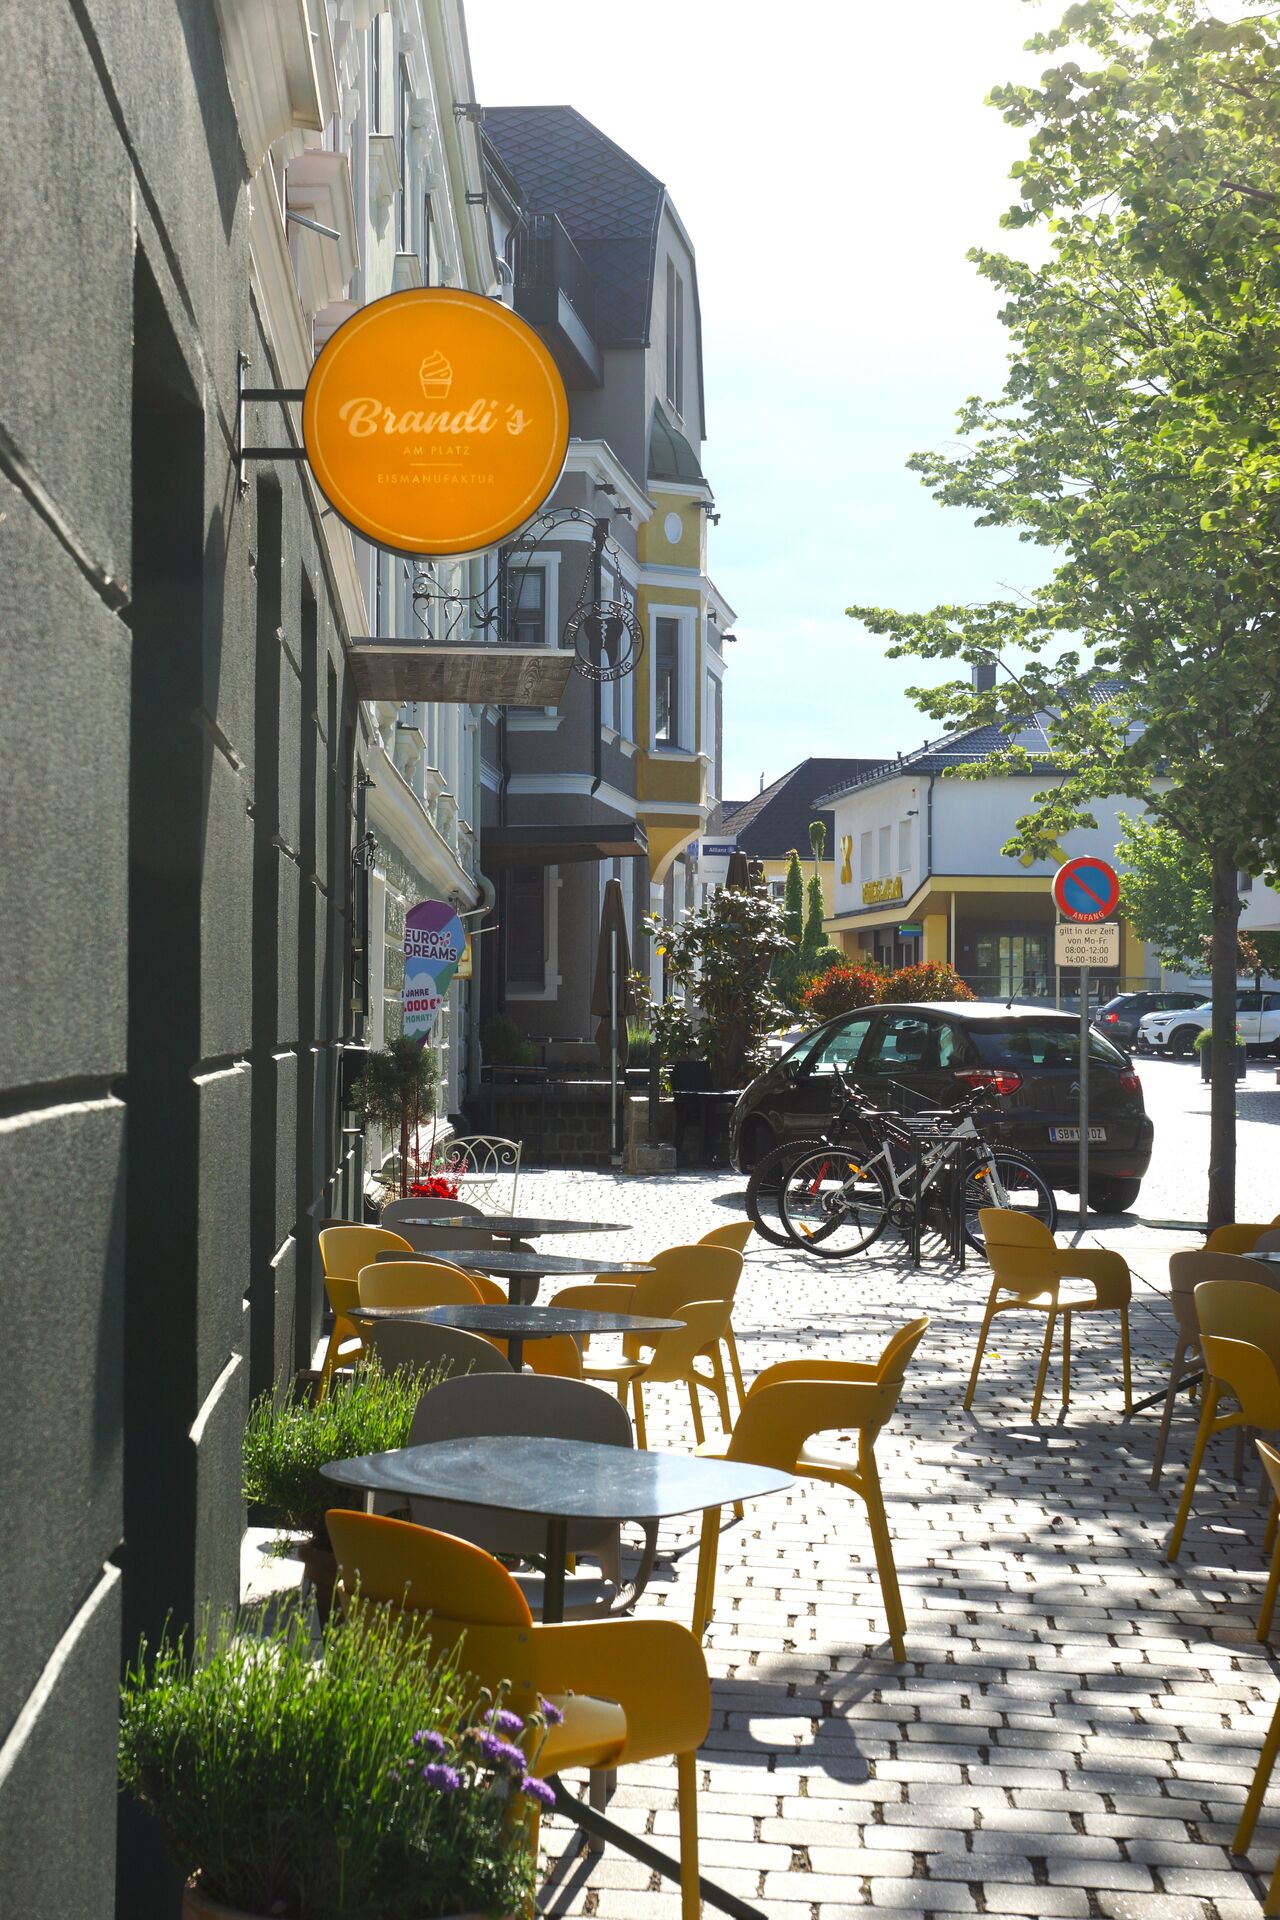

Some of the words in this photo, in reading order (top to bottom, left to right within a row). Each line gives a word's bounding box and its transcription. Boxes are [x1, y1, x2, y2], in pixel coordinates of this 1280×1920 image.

[338, 397, 533, 438] Brandi's
[403, 446, 424, 455] AM
[431, 446, 470, 456] PLATZ
[377, 474, 495, 484] EISMANUFAKTUR
[1072, 911, 1105, 920] ANFANG
[1059, 927, 1072, 936] gilt
[1075, 927, 1082, 935] in
[1084, 927, 1097, 935] der
[1099, 927, 1114, 935] Zeit
[404, 929, 439, 945] EURO
[404, 943, 457, 961] DREAMS
[1065, 946, 1109, 954] 08:00-12:00
[405, 988, 429, 997] JAHRE
[405, 1013, 432, 1023] MONAT!
